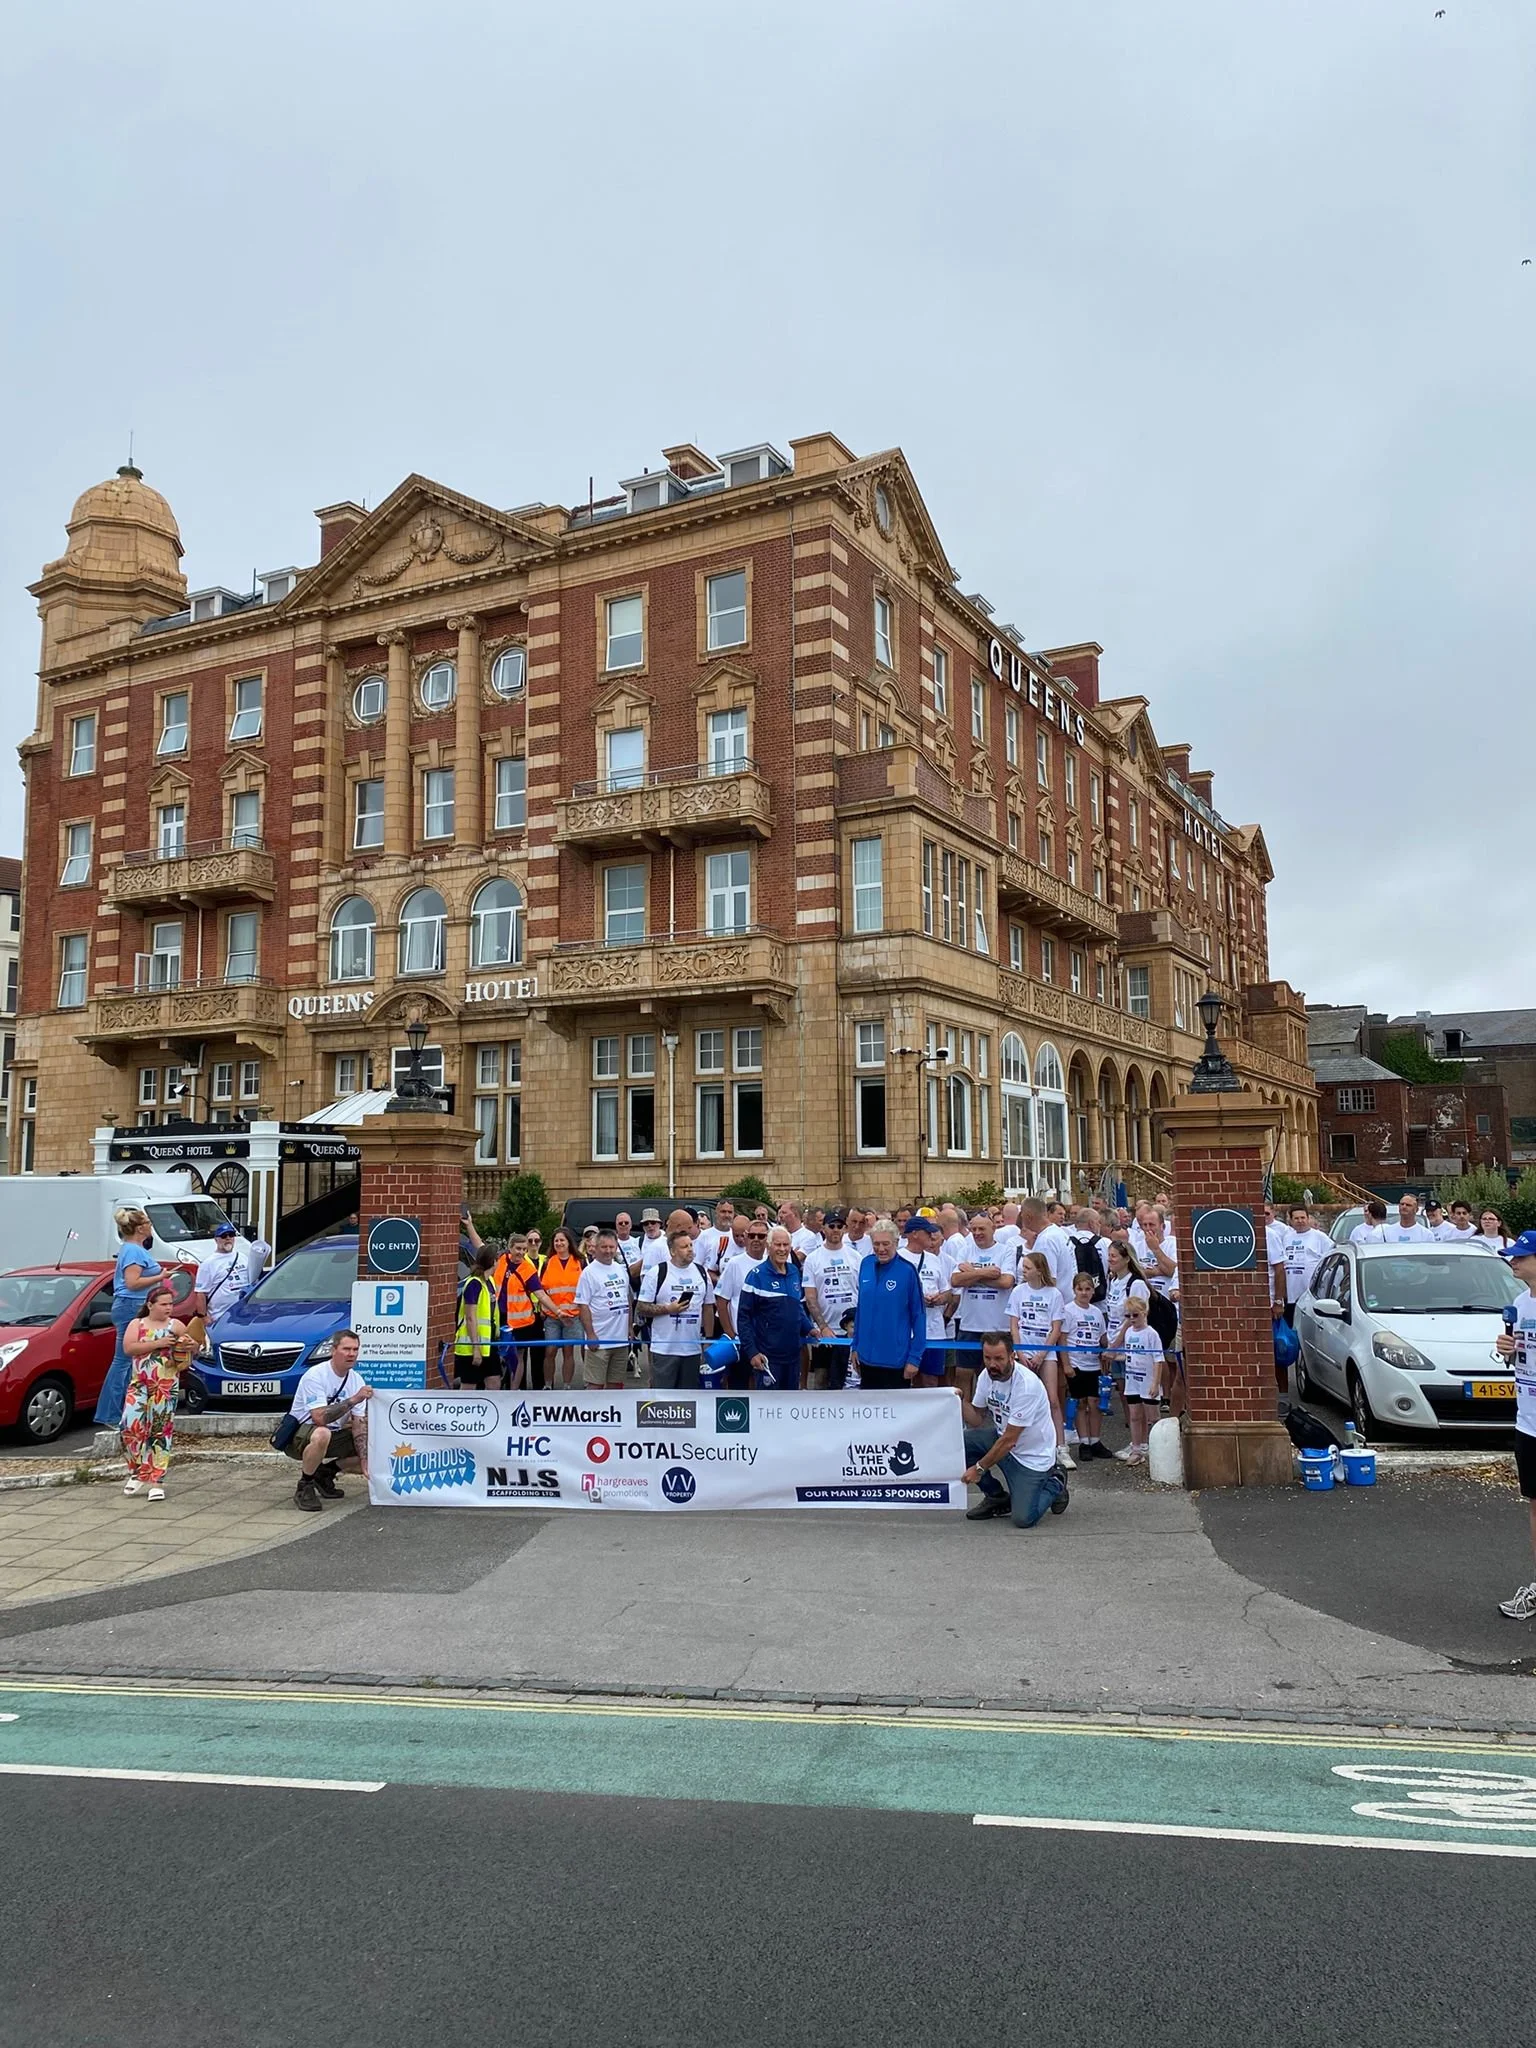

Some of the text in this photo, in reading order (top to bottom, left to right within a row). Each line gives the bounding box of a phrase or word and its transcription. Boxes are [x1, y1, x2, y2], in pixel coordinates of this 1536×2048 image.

[990, 638, 1085, 746] QUEENS
[1183, 809, 1225, 863] HOTEL
[288, 991, 375, 1019] QUEENS
[150, 1145, 184, 1159] QUEENS
[187, 1145, 213, 1156] HOTEL
[310, 1143, 345, 1157] QUEENS
[1198, 1235, 1251, 1244] NO ENTRY
[371, 1242, 417, 1250] NO ENTRY
[355, 1323, 422, 1335] Patrons Only
[227, 1382, 274, 1393] CK15 FXU
[1479, 1385, 1515, 1396] 41-SV
[398, 1403, 488, 1417] S & O Property
[532, 1405, 622, 1423] FWMarsh
[647, 1405, 692, 1419] Nesbits
[757, 1407, 897, 1420] THE QUEENS HOTEL
[401, 1419, 485, 1431] Services South
[507, 1436, 551, 1457] HFC
[854, 1445, 890, 1454] WALK
[388, 1447, 467, 1475] VICTORIOUS
[859, 1455, 884, 1465] THE
[842, 1466, 888, 1476] ISLAND
[597, 1476, 648, 1488] hargreaves
[603, 1490, 649, 1498] promotions
[805, 1490, 829, 1498] OUR
[885, 1489, 942, 1499] SPONSORS
